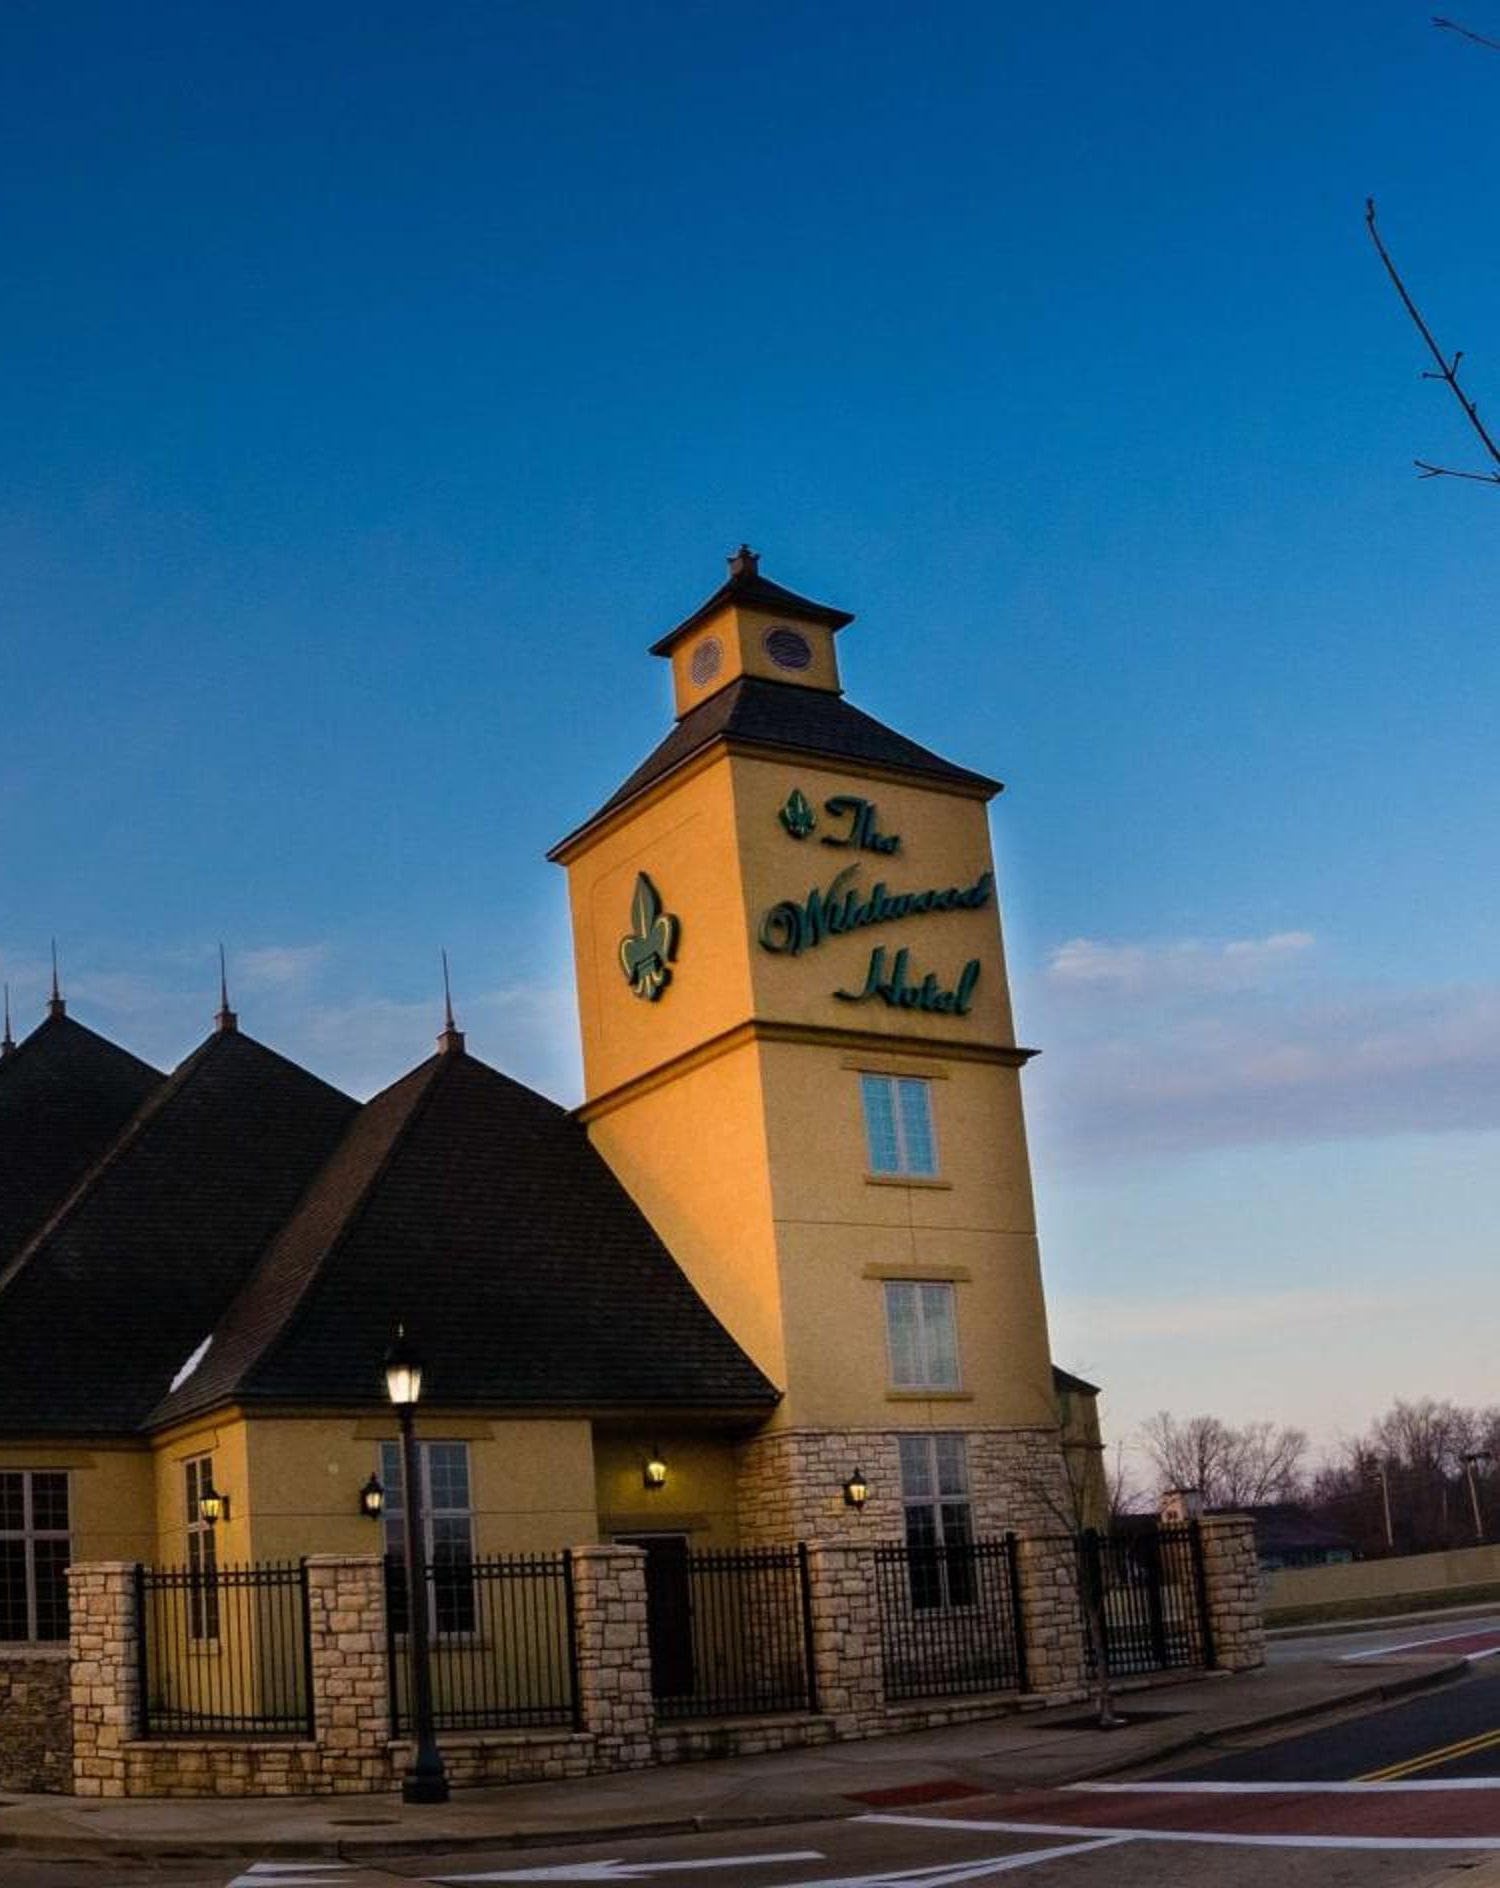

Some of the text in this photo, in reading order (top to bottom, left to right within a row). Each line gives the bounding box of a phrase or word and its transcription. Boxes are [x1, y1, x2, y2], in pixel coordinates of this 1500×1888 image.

[821, 796, 901, 854] The
[758, 864, 994, 956] Wildwood
[833, 947, 980, 1016] Hotel
